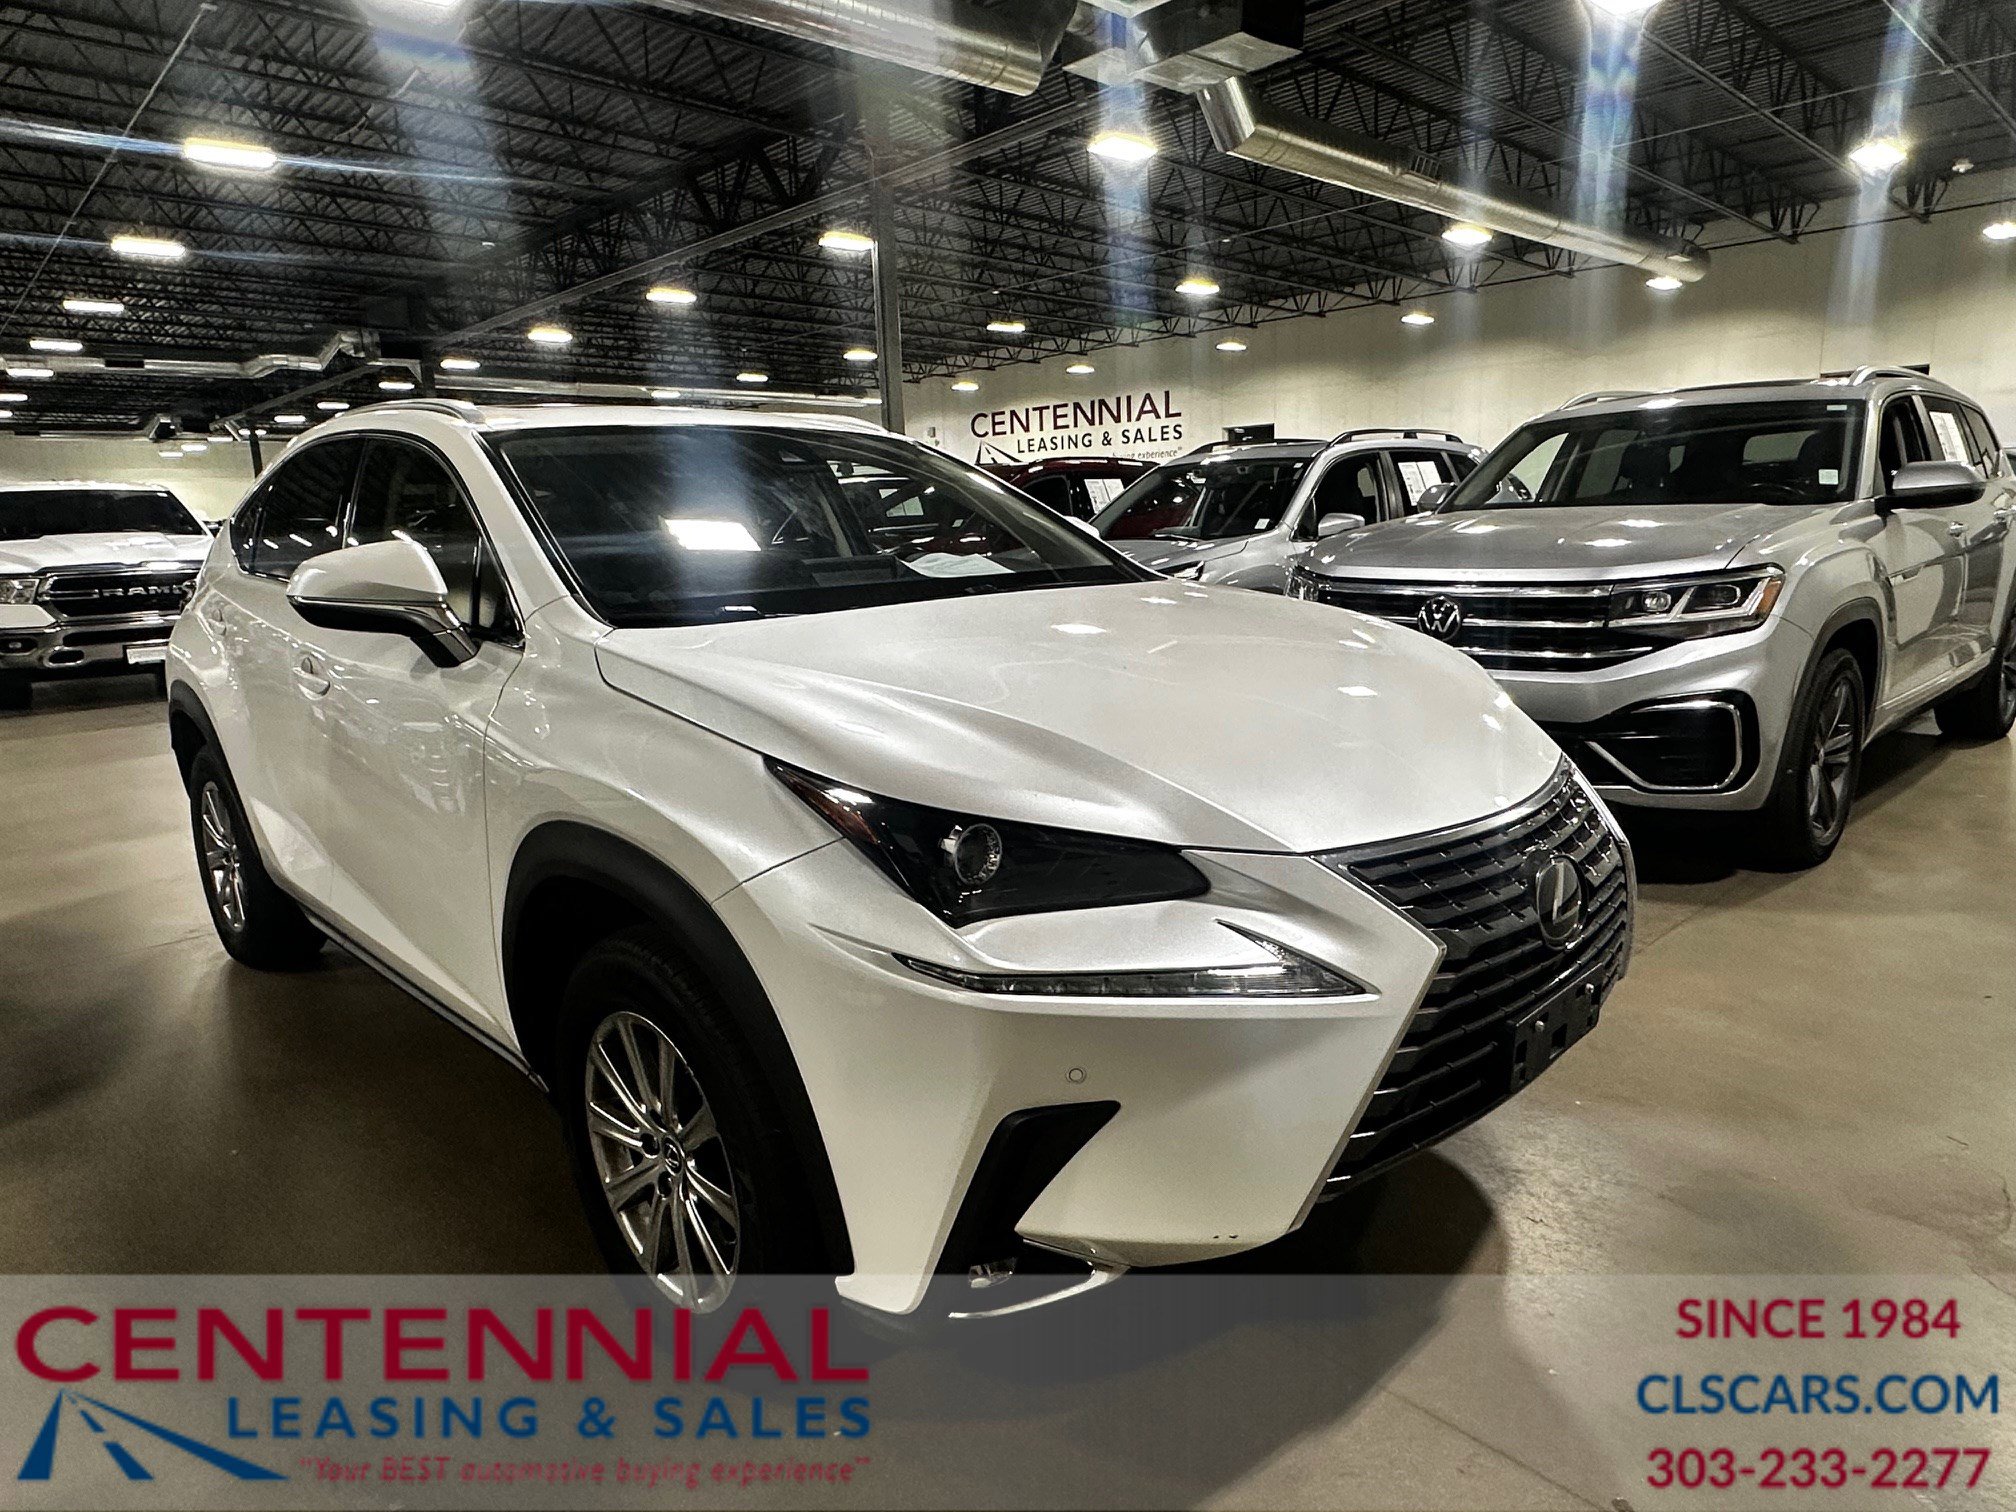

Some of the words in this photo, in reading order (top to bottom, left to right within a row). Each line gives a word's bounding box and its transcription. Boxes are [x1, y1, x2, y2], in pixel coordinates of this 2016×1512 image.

[971, 390, 1182, 438] CENTENNIAL
[1017, 432, 1093, 454] LEASING
[1101, 431, 1113, 446] &
[1121, 424, 1183, 444] SALES
